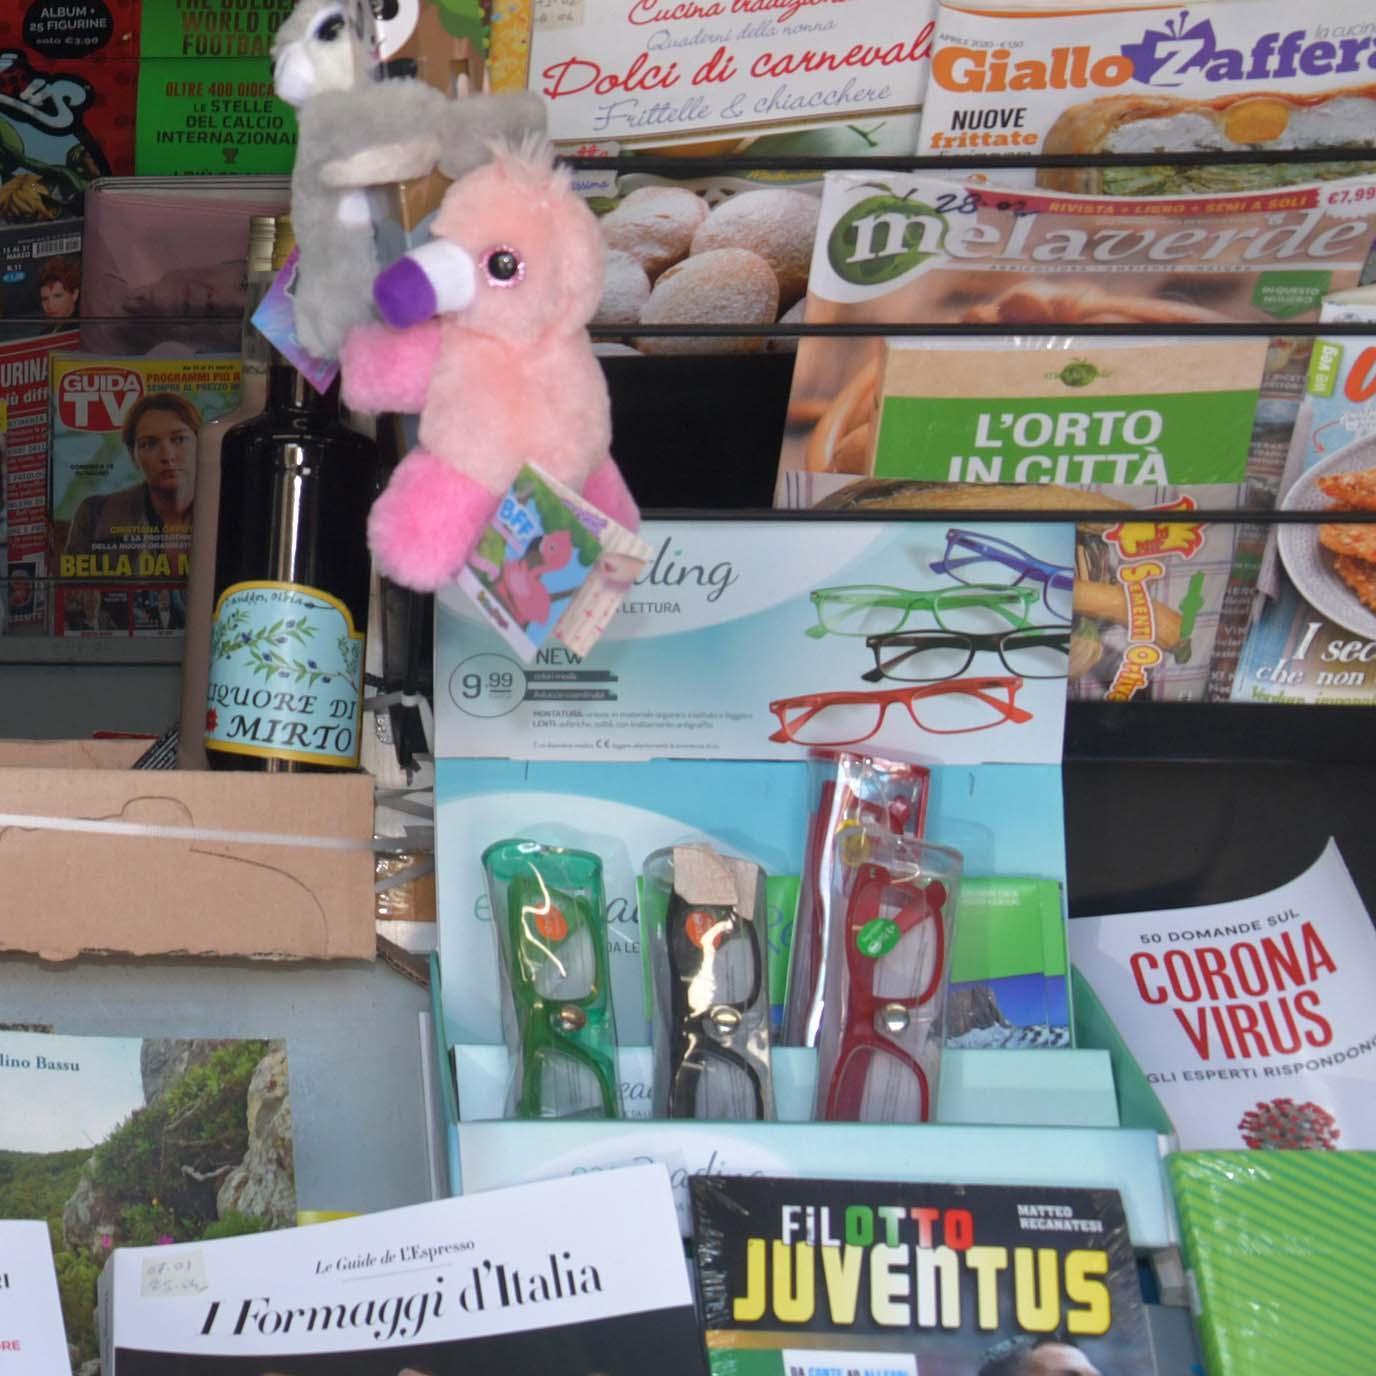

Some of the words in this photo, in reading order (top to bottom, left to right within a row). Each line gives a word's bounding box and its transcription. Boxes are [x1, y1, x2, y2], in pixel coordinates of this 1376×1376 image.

[542, 53, 681, 100] Dolci
[691, 45, 737, 85] di
[930, 44, 1135, 94] Giallo
[593, 94, 710, 132] Frittelle
[950, 107, 1027, 131] NUOVE
[929, 130, 1039, 150] frittate
[845, 208, 1369, 265] melaverde
[62, 374, 141, 393] GUIDA
[973, 410, 1164, 449] L'ORTO
[948, 456, 1002, 484] IN
[1015, 447, 1170, 485] CITTÀ
[59, 553, 133, 577] BELLA
[139, 553, 170, 577] DA
[622, 601, 681, 614] LETTURA
[535, 647, 583, 665] NEW
[329, 699, 356, 720] DI
[226, 714, 353, 753] MIRTO
[1140, 933, 1162, 944] 50
[1168, 920, 1262, 943] DOMANDE
[1266, 908, 1301, 926] SUL
[1129, 921, 1337, 1005] CORONA
[1172, 990, 1333, 1061] VIRUS
[34, 1054, 81, 1074] Bassu
[314, 1259, 334, 1275] Le
[335, 1254, 377, 1274] Guide
[379, 1250, 397, 1265] de
[399, 1239, 476, 1265] L'Espresso
[197, 1300, 225, 1337] I
[231, 1277, 446, 1341] Formaggi
[458, 1250, 606, 1314] d'Italia
[731, 1237, 1112, 1337] JUVENTUS
